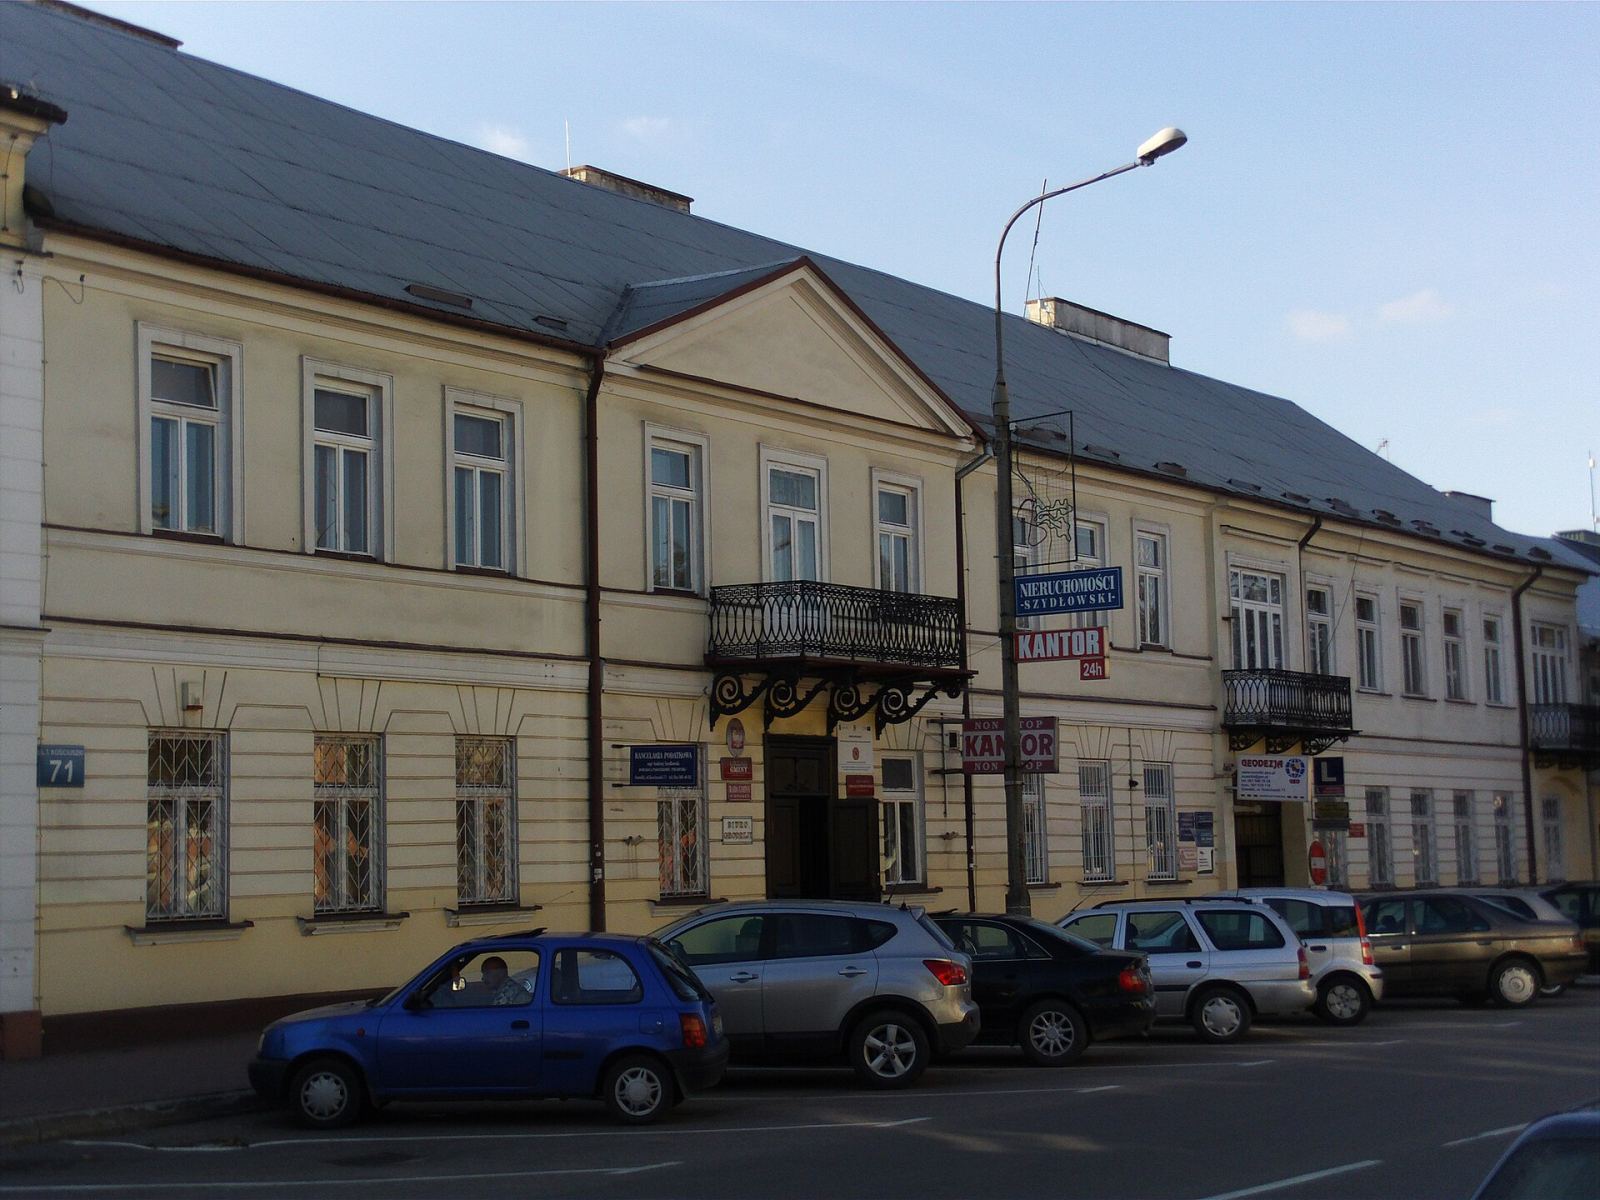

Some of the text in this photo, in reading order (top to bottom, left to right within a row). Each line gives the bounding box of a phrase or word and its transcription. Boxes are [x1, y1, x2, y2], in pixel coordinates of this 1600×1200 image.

[1020, 574, 1115, 597] NIERUCHOMOŚCI
[1018, 630, 1100, 659] KANTOR
[1083, 662, 1103, 677] 24h
[975, 720, 1043, 730] NON TOP
[965, 733, 1053, 757] KANOR
[49, 759, 74, 783] 71
[974, 762, 999, 771] NON
[1241, 759, 1283, 769] GEODEZJA
[1320, 761, 1337, 782] L
